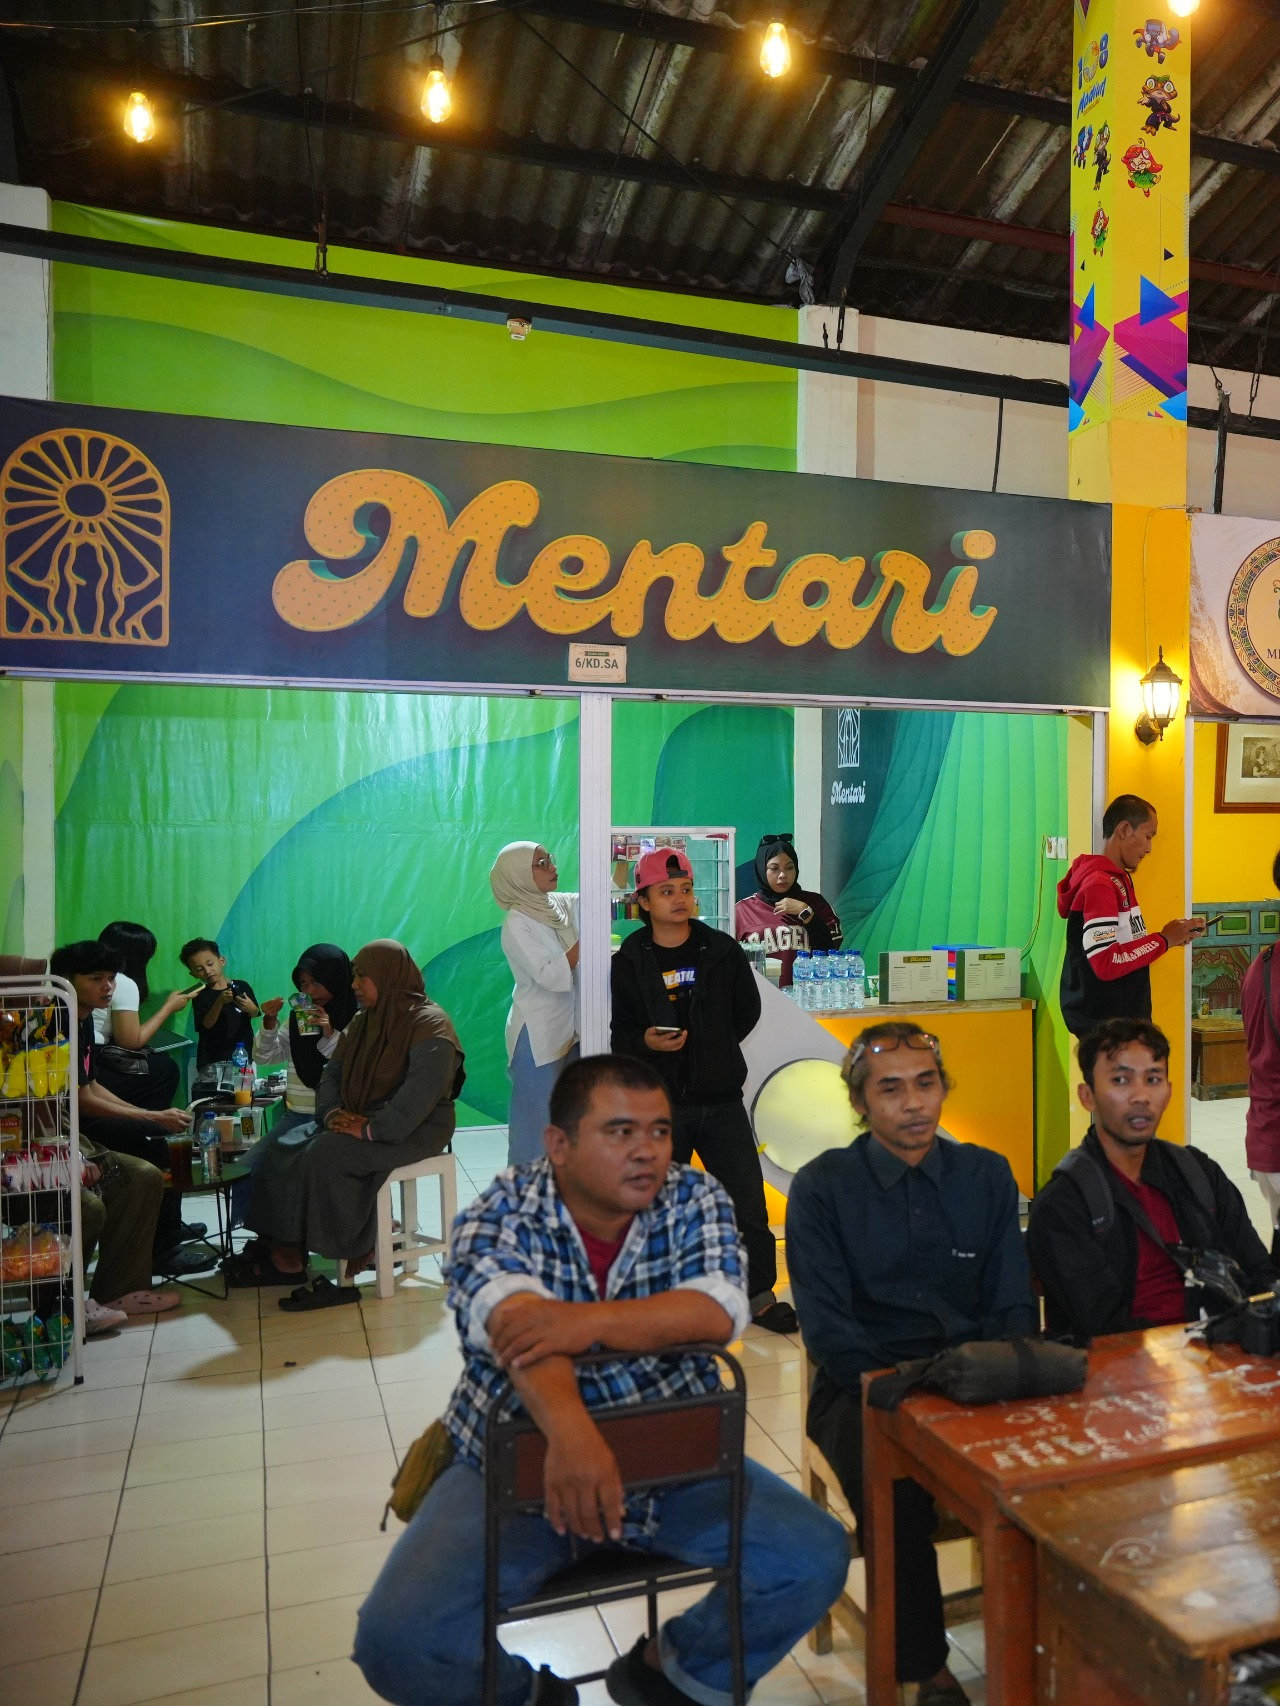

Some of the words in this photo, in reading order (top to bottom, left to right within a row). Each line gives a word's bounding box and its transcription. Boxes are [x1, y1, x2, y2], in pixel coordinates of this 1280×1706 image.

[271, 467, 998, 657] Mentari
[575, 657, 619, 669] 6/KD.SA
[831, 780, 866, 805] Mentari
[1132, 940, 1160, 958] WHEELS
